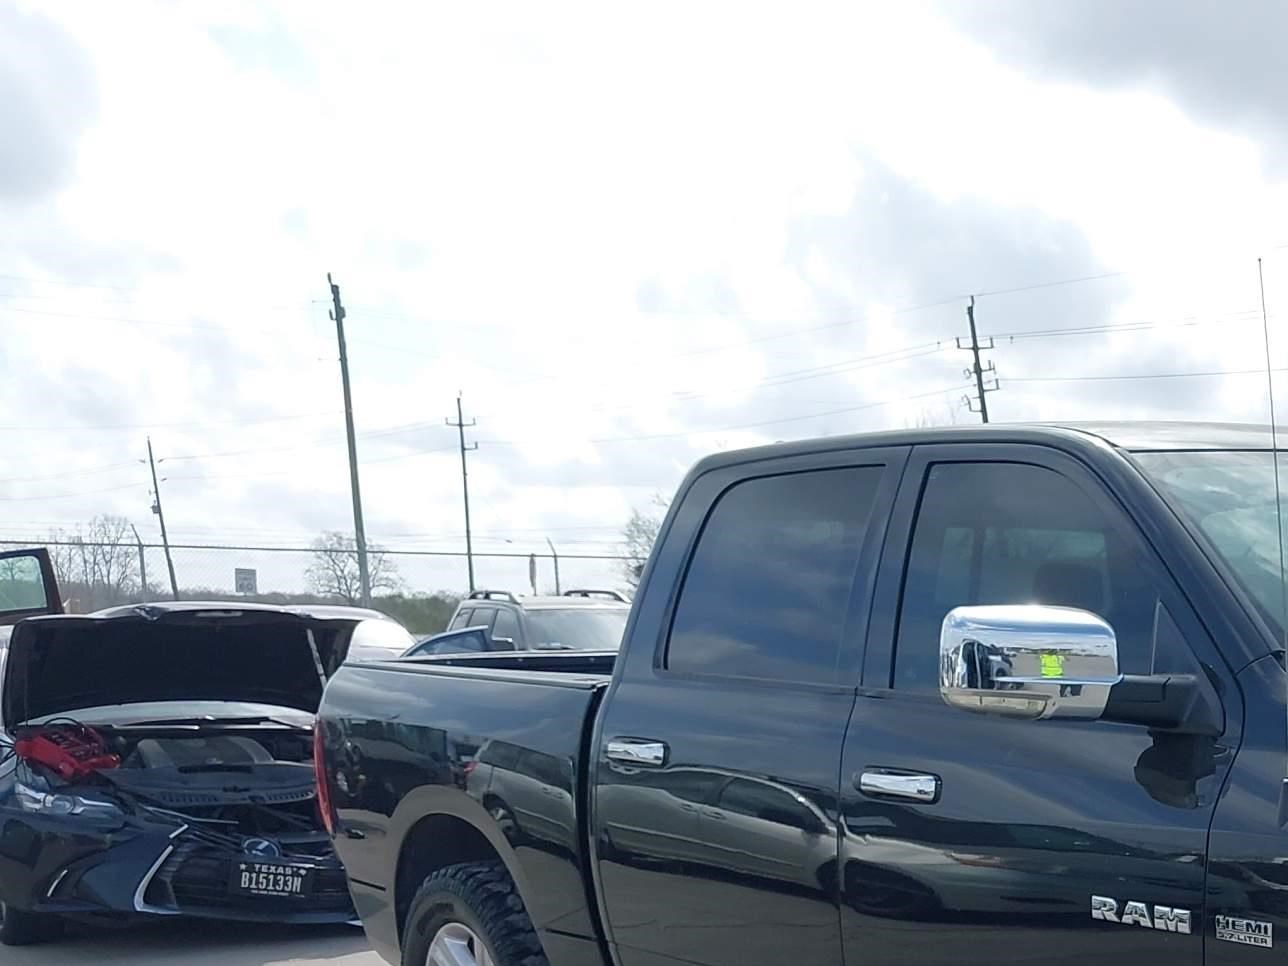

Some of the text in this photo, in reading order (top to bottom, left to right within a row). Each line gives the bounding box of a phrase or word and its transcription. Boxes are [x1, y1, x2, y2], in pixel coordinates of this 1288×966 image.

[254, 864, 292, 875] TEXAS
[1090, 895, 1192, 934] RAM
[1215, 915, 1270, 936] HEMI
